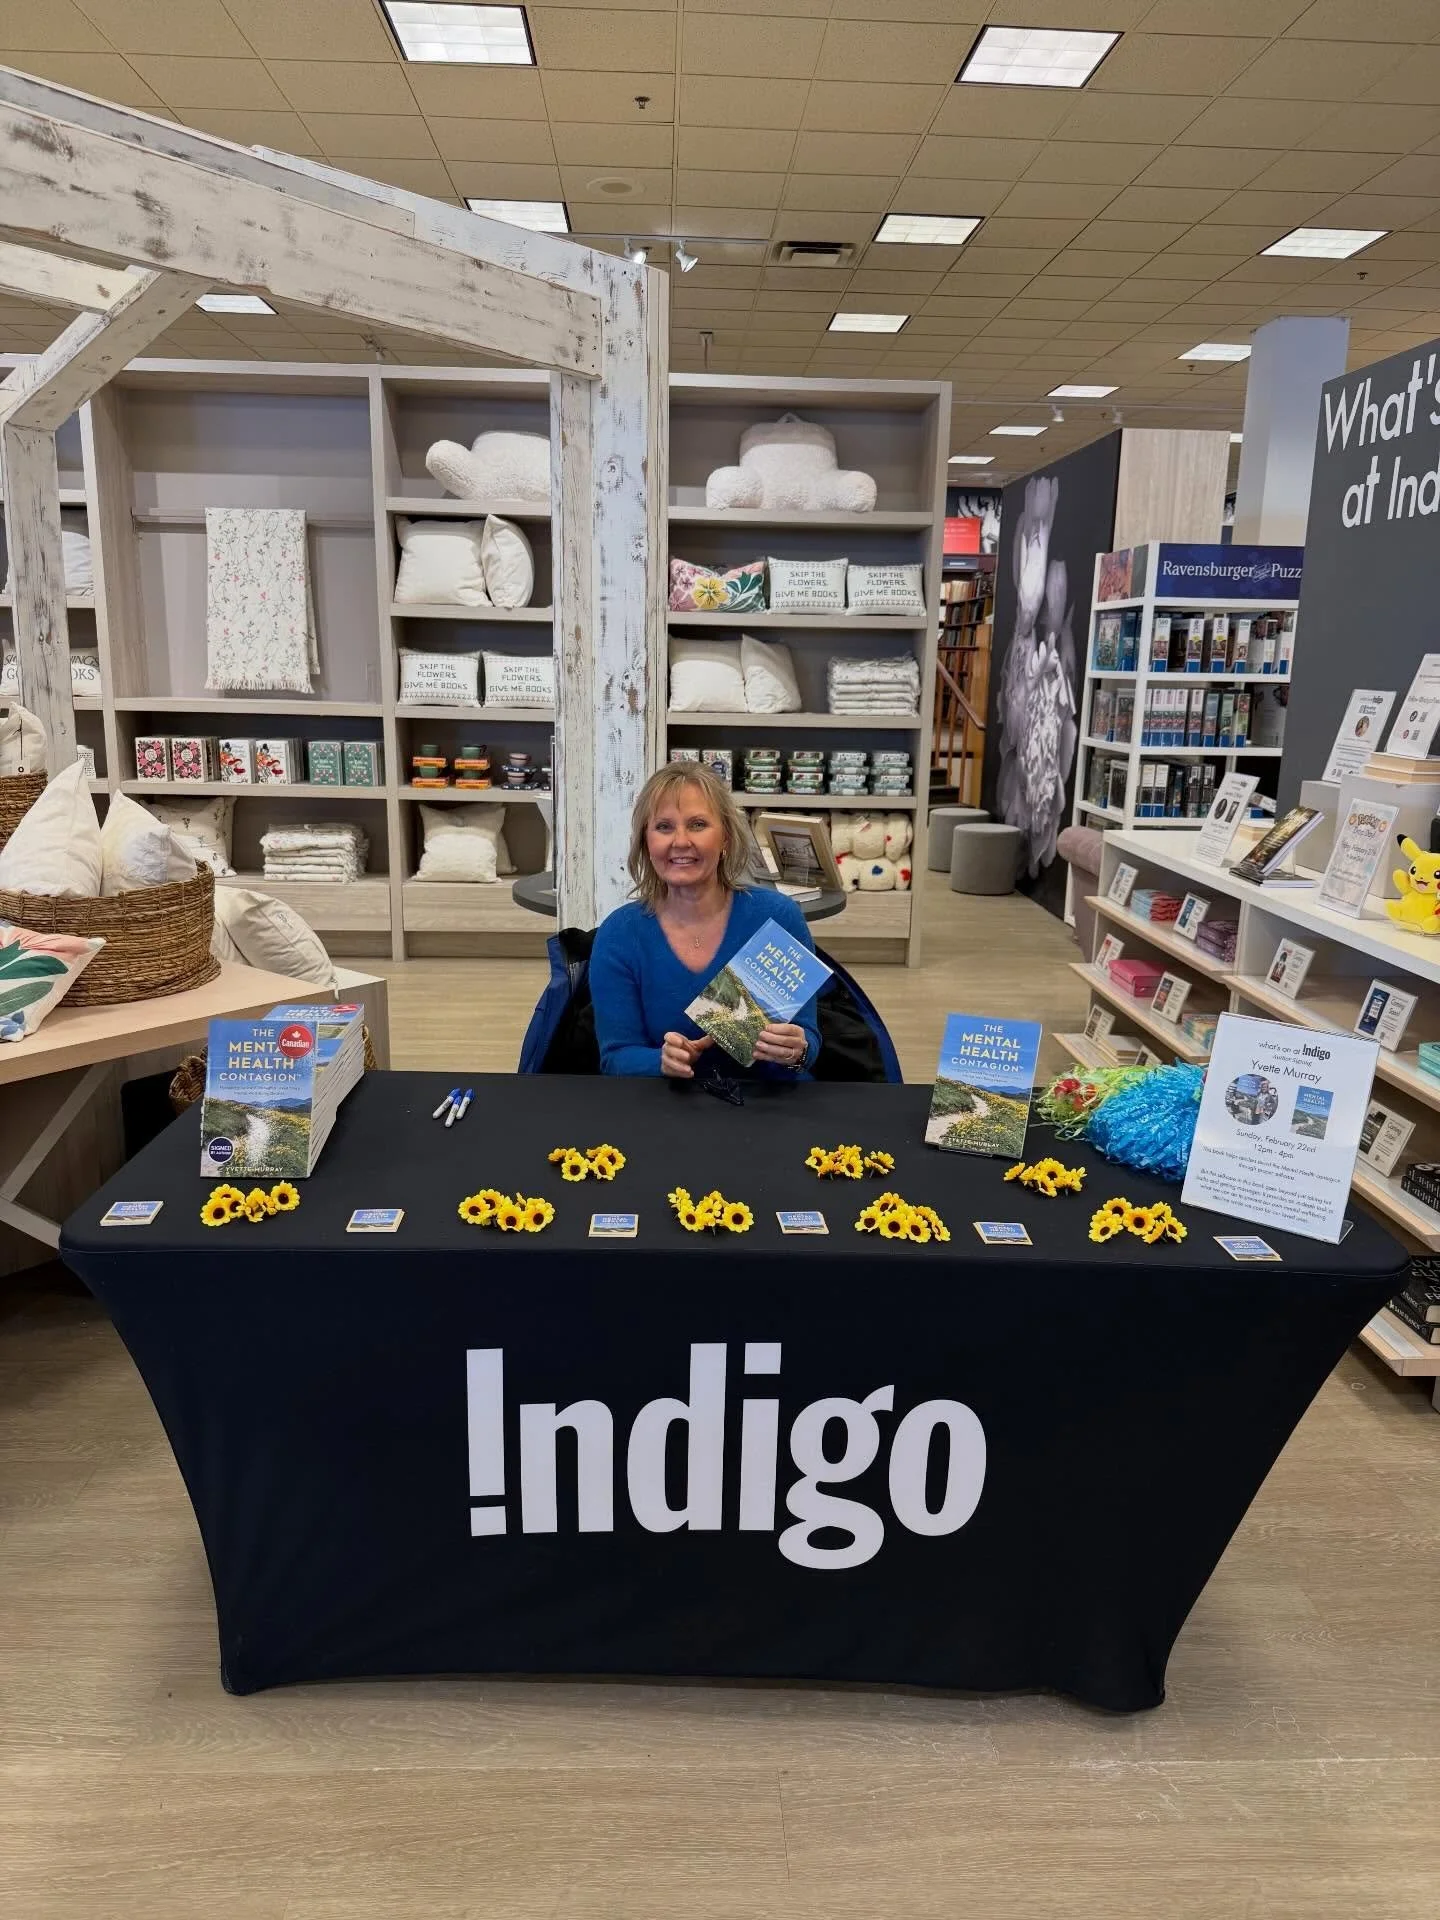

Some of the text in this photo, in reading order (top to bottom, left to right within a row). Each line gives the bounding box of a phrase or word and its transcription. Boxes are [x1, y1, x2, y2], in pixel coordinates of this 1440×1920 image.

[1342, 456, 1381, 528] at
[1163, 561, 1254, 581] Ravensburger
[812, 590, 838, 598] BOOKS
[855, 590, 874, 598] GIVE
[441, 682, 468, 690] BOOKS
[526, 685, 552, 693] BOOKS
[787, 946, 801, 961] THE
[765, 941, 808, 983] MENTAL
[756, 952, 800, 992] HEALTH
[252, 1029, 275, 1037] THE
[984, 1024, 1004, 1033] THE
[281, 1038, 310, 1049] Canadian
[962, 1032, 1021, 1049] MENTAL
[1258, 1041, 1280, 1051] what's
[960, 1046, 1018, 1062] HEALTH
[228, 1056, 294, 1070] HEALTH
[1252, 1059, 1322, 1084] Yvette Murray
[1254, 1144, 1273, 1154] 12pm
[1278, 1150, 1294, 1159] 4pm
[1266, 1136, 1295, 1150] February
[1297, 1143, 1316, 1153] 22nd
